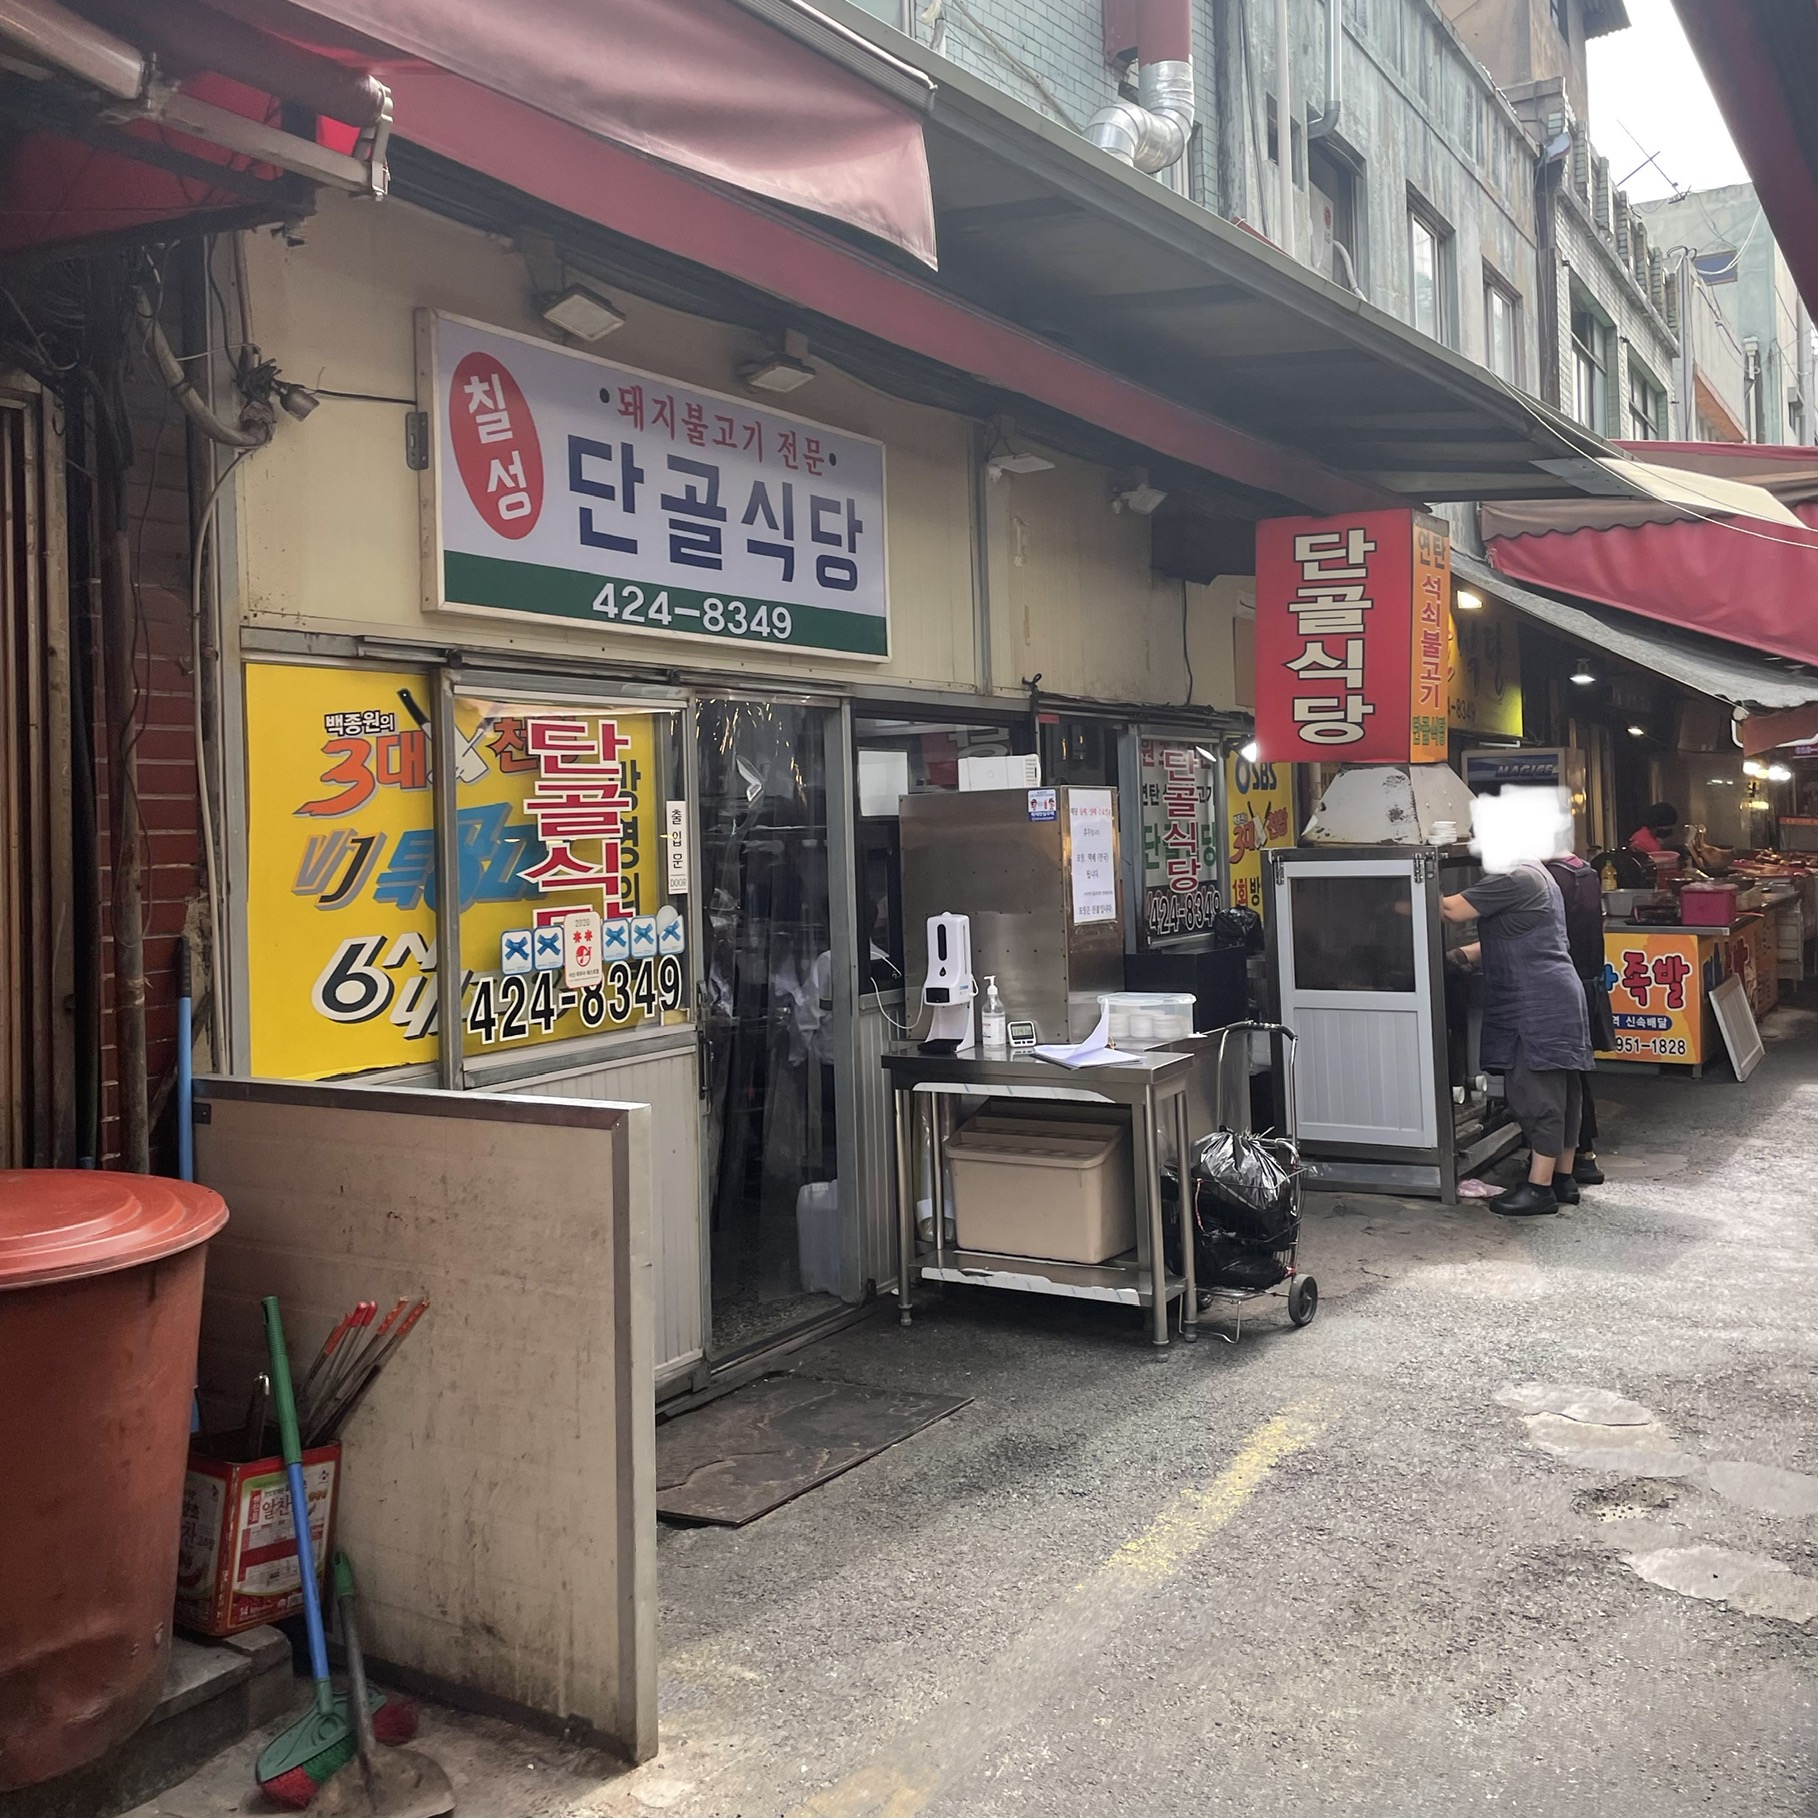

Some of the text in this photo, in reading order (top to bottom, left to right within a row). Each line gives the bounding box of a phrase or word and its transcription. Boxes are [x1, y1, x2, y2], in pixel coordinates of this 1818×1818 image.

[464, 373, 533, 521] 칠성
[617, 384, 825, 476] 돼지불고기 전문
[568, 434, 863, 592] 단골식당
[1418, 530, 1446, 570] 연탄
[592, 583, 794, 640] 424-8349
[1282, 528, 1377, 744] 단골식당
[1420, 575, 1442, 708] 석쇠불고기
[324, 711, 395, 737] 백종원의
[1448, 697, 1477, 722] -8349
[1252, 762, 1277, 790] SBS
[671, 809, 683, 869] 출입문
[1161, 749, 1202, 893] 단골식당
[670, 878, 687, 888] DOOR
[468, 955, 683, 1045] 424-8349
[1626, 1016, 1667, 1029] 신속배달
